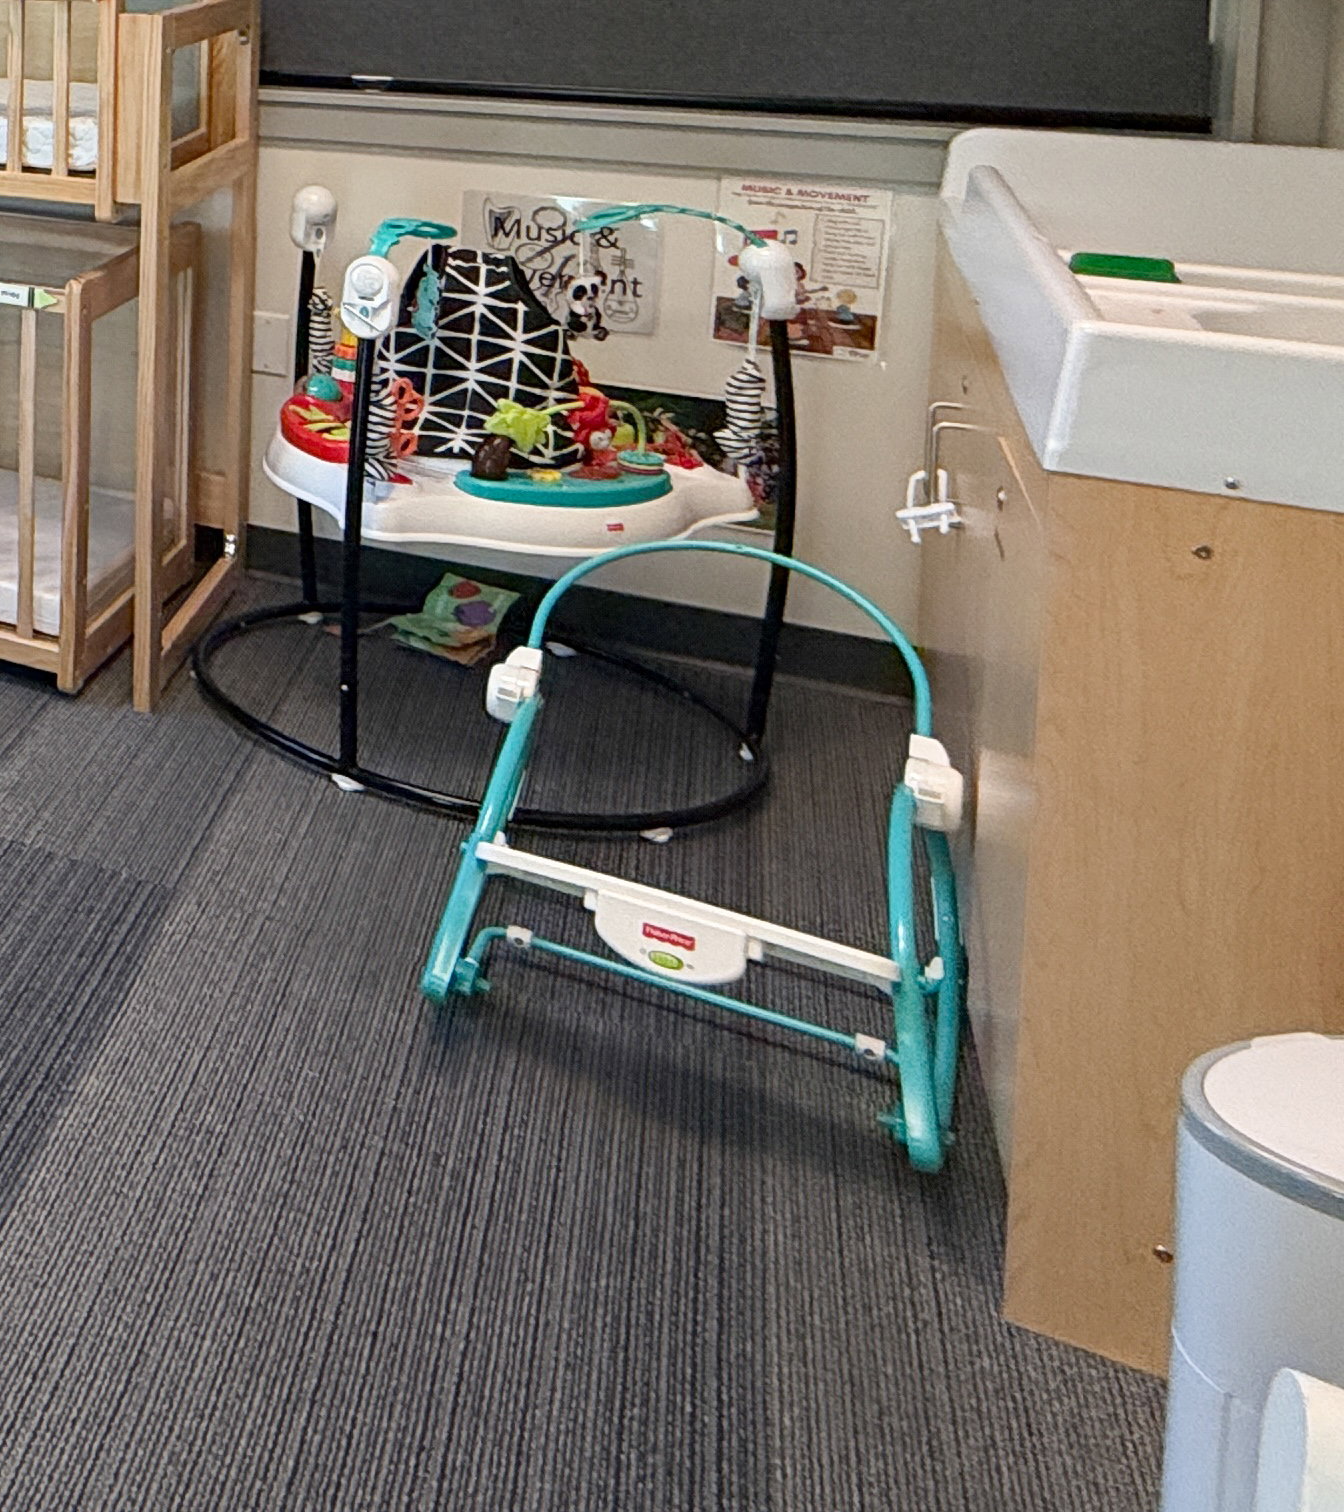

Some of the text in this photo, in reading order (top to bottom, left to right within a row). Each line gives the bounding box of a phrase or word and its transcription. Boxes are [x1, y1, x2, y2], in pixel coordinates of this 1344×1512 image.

[741, 184, 782, 195] MUSIC
[797, 190, 871, 204] MOVEMENT
[493, 216, 581, 246] Music
